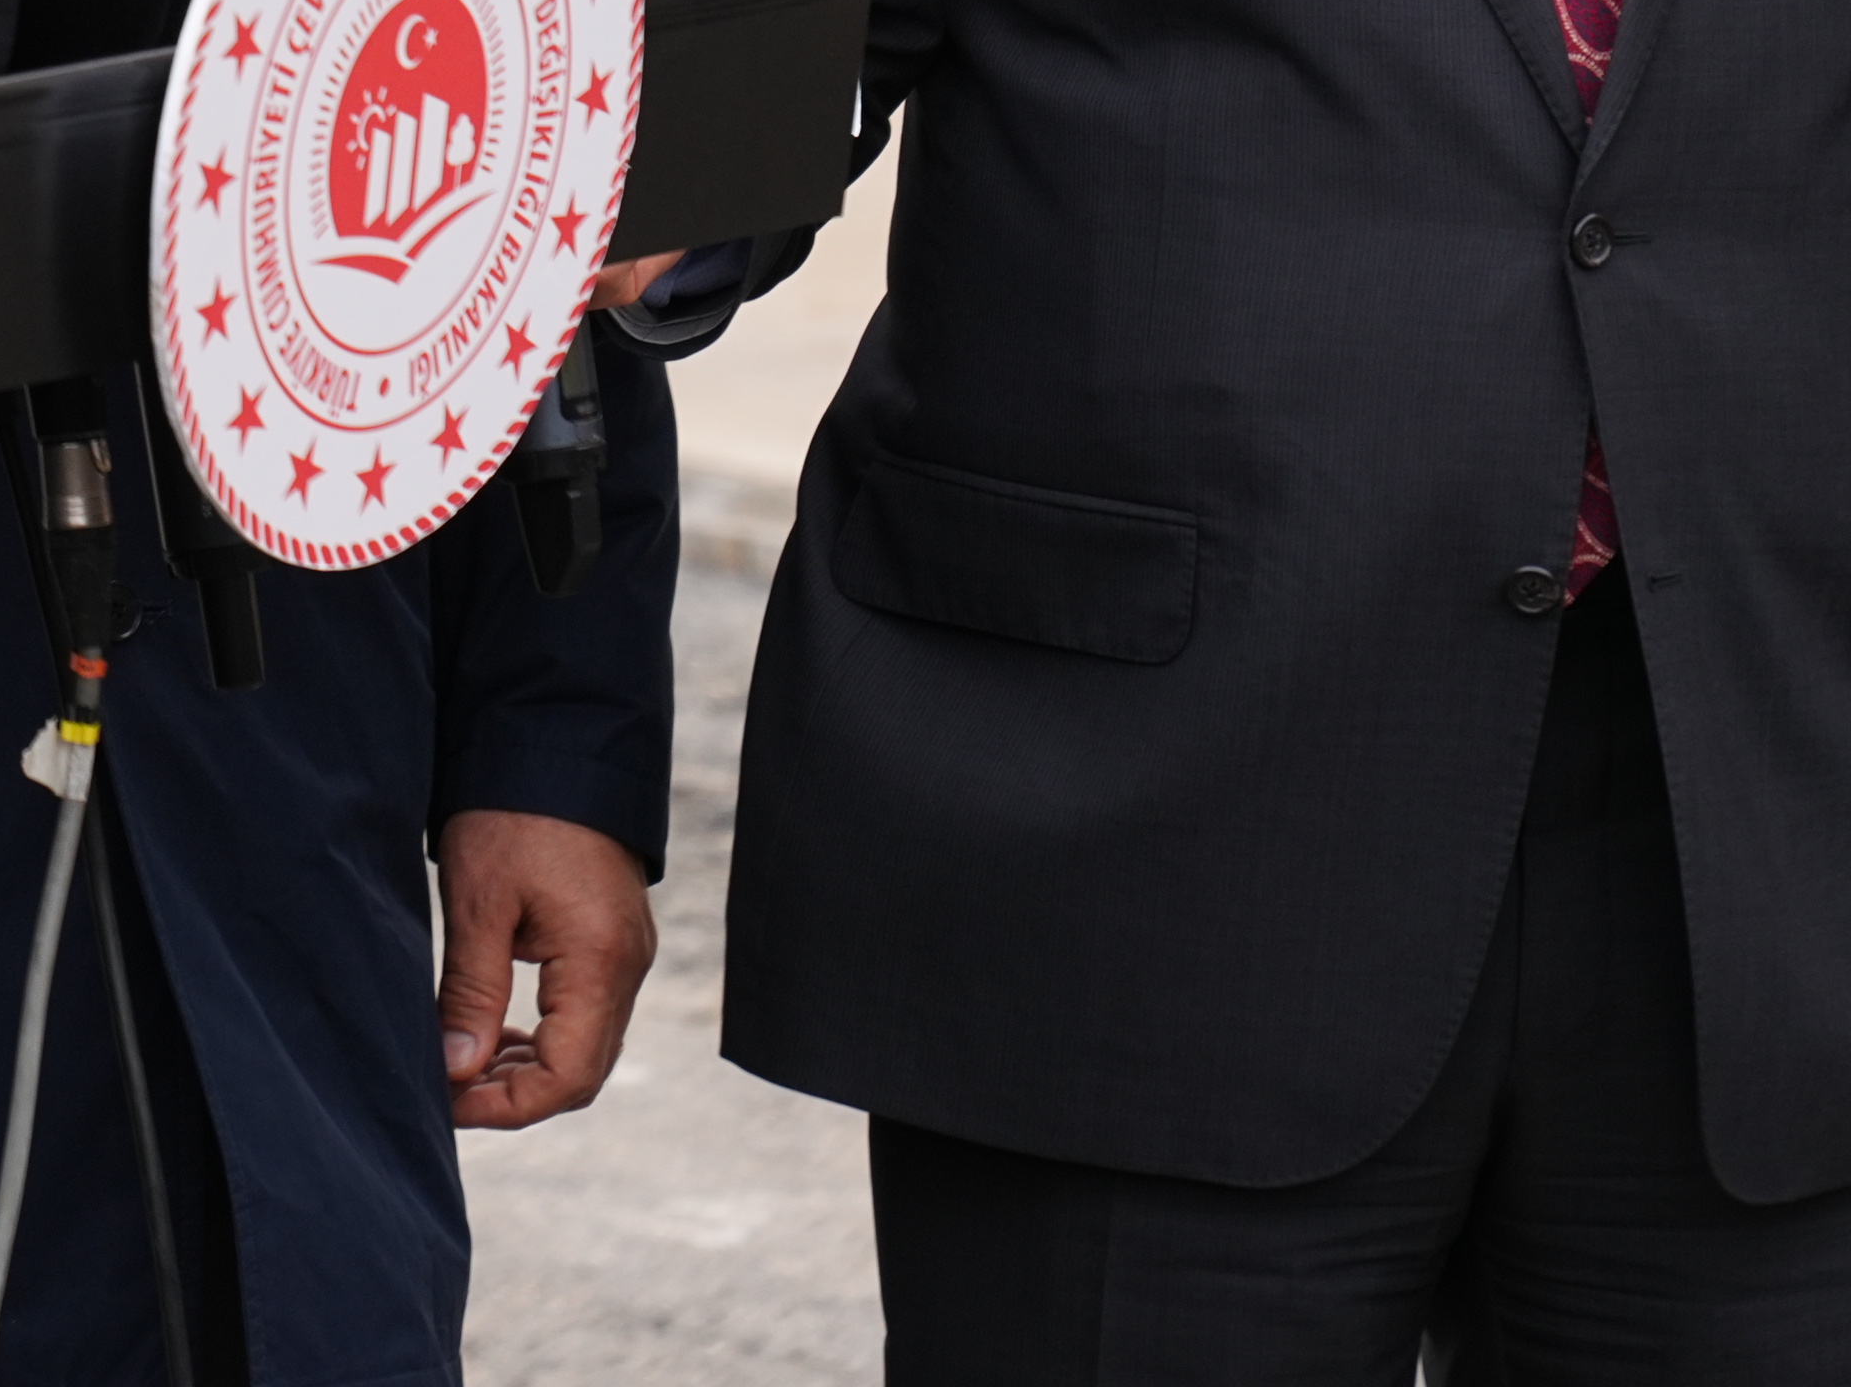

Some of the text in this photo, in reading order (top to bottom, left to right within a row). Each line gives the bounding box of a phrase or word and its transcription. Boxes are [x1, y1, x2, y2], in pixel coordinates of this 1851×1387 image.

[249, 58, 297, 331] CUMHURİYETİ
[278, 321, 362, 419] TÜRKİYE
[408, 233, 523, 401] BAKANLIĞI
